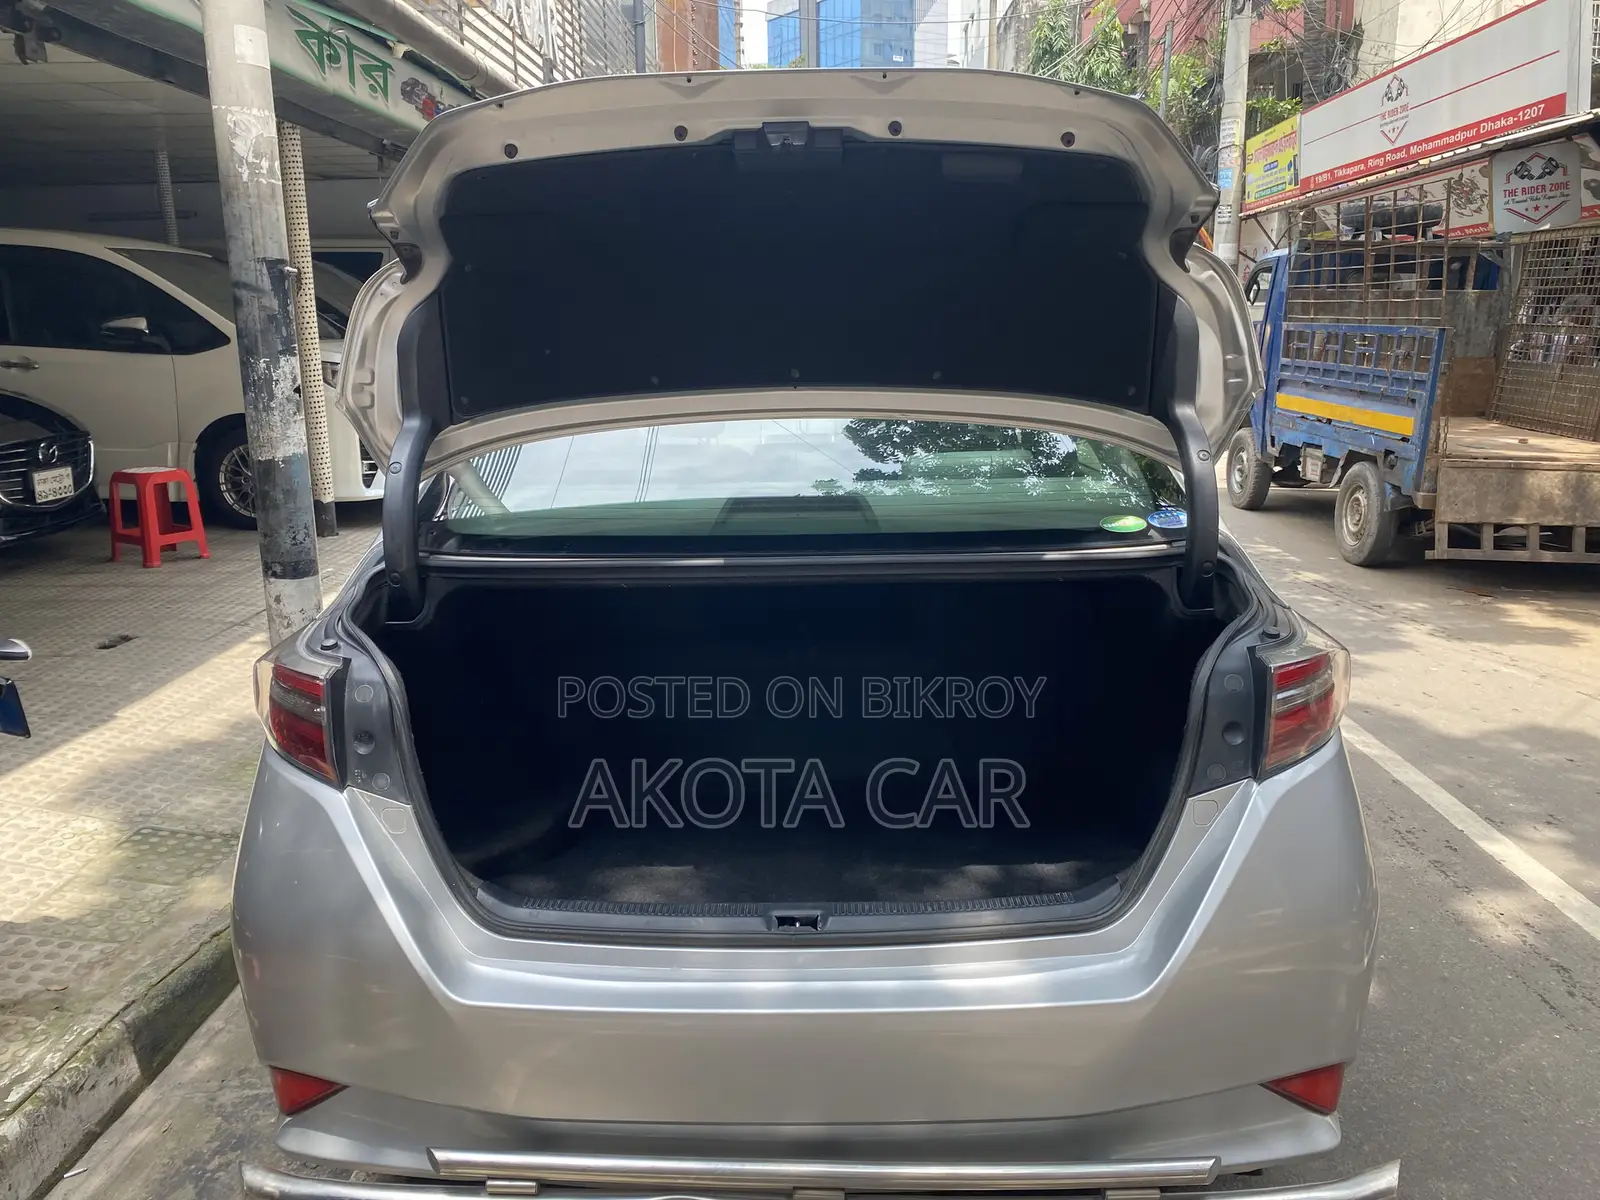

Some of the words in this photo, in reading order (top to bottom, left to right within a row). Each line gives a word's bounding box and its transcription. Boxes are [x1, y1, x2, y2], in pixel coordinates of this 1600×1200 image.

[284, 3, 396, 105] কার
[1333, 163, 1367, 179] Tikkapara,
[1367, 156, 1385, 169] Ring
[1385, 150, 1408, 163] Road,
[1409, 127, 1478, 156] Mohammadpur
[1479, 103, 1546, 134] Dhaka-1207
[1503, 187, 1519, 199] THE
[1521, 184, 1547, 197] RIDER
[1549, 180, 1571, 193] ZONE
